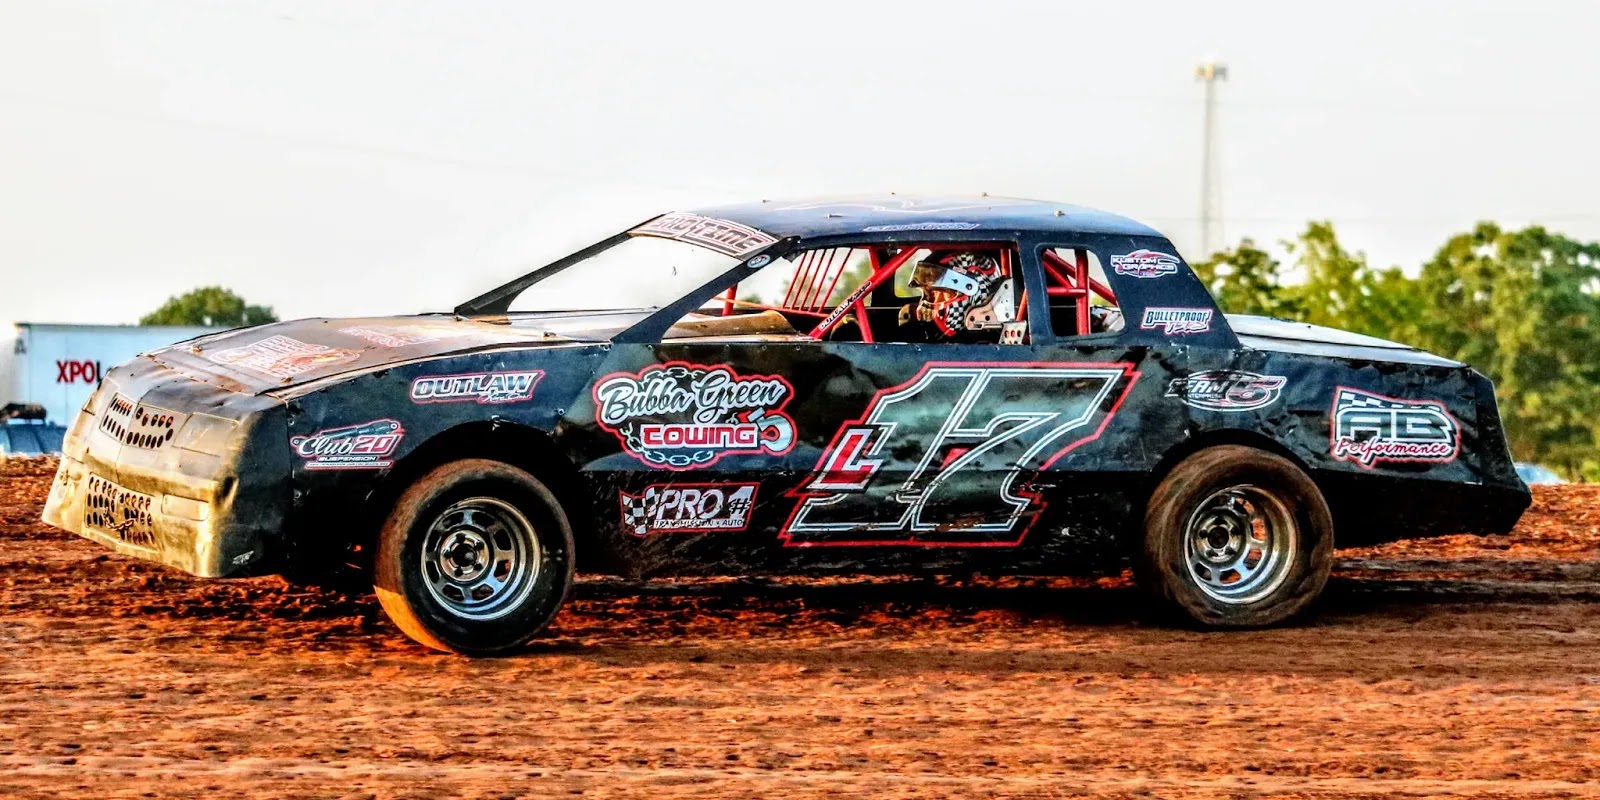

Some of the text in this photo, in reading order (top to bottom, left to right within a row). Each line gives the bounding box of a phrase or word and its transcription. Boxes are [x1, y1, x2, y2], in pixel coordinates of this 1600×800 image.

[1112, 256, 1158, 264] KUSTOM
[1145, 310, 1209, 324] BULLETPROOF
[411, 372, 538, 399] OUTLAW
[598, 369, 787, 425] Bubba Green
[642, 425, 757, 446] TOWING
[1336, 437, 1450, 463] Performance
[655, 488, 724, 520] PRO
[721, 519, 743, 527] AUTO
